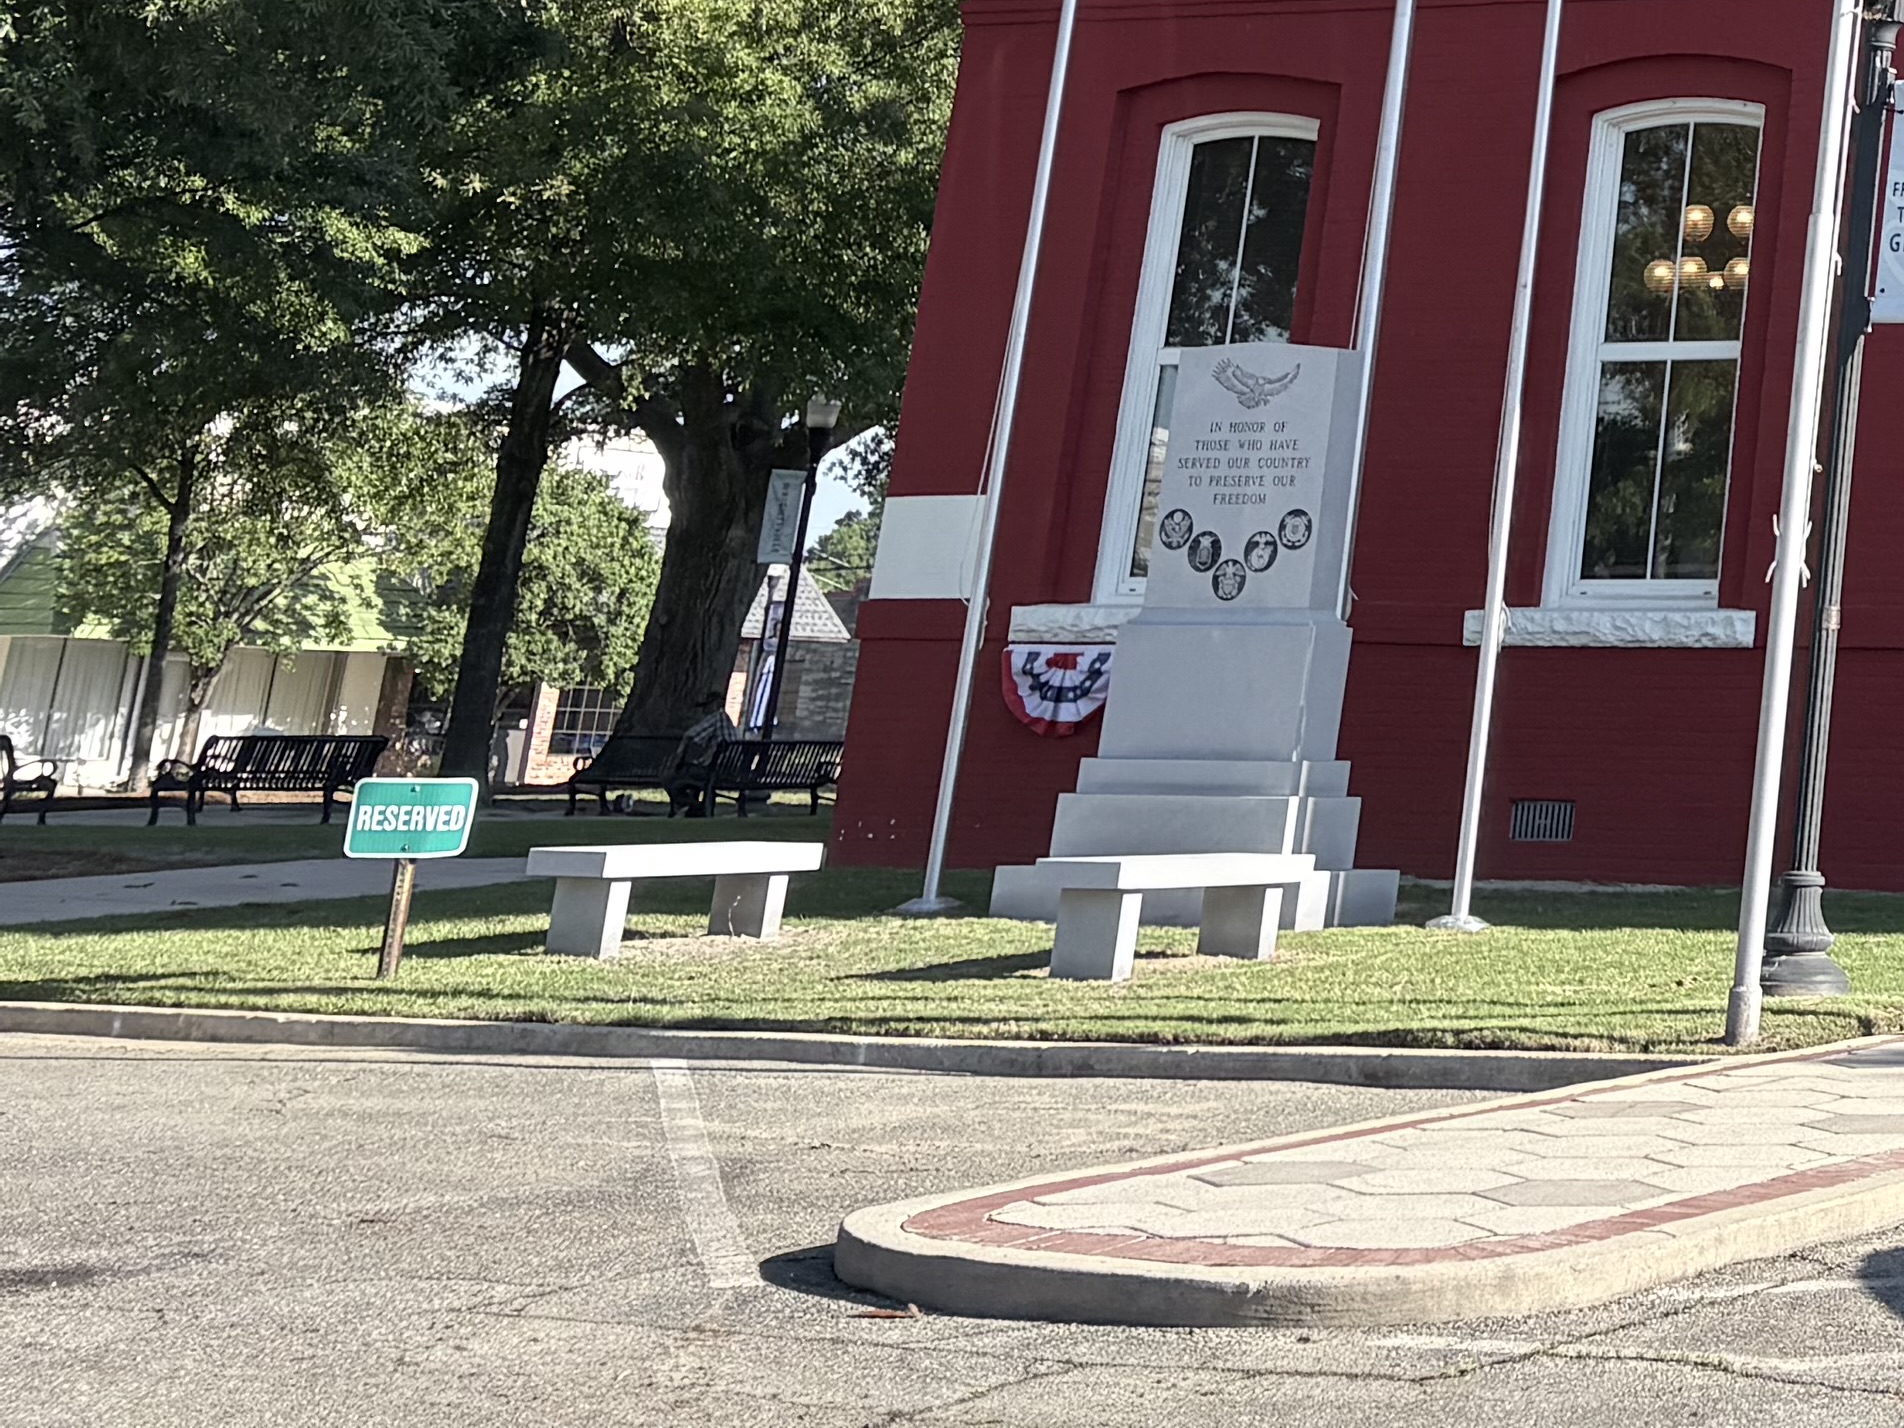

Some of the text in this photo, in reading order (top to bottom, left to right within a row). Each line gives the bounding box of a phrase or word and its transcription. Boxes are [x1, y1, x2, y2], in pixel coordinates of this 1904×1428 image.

[1210, 421, 1288, 433] IN HONOR OF
[1194, 439, 1299, 451] THOSE WHO HAVE
[1177, 457, 1311, 469] SERVED OUR COUNTRY
[1188, 475, 1296, 487] TO PRESERVE OUR
[1213, 493, 1267, 505] FREEDOM
[356, 805, 466, 831] RESERVED
